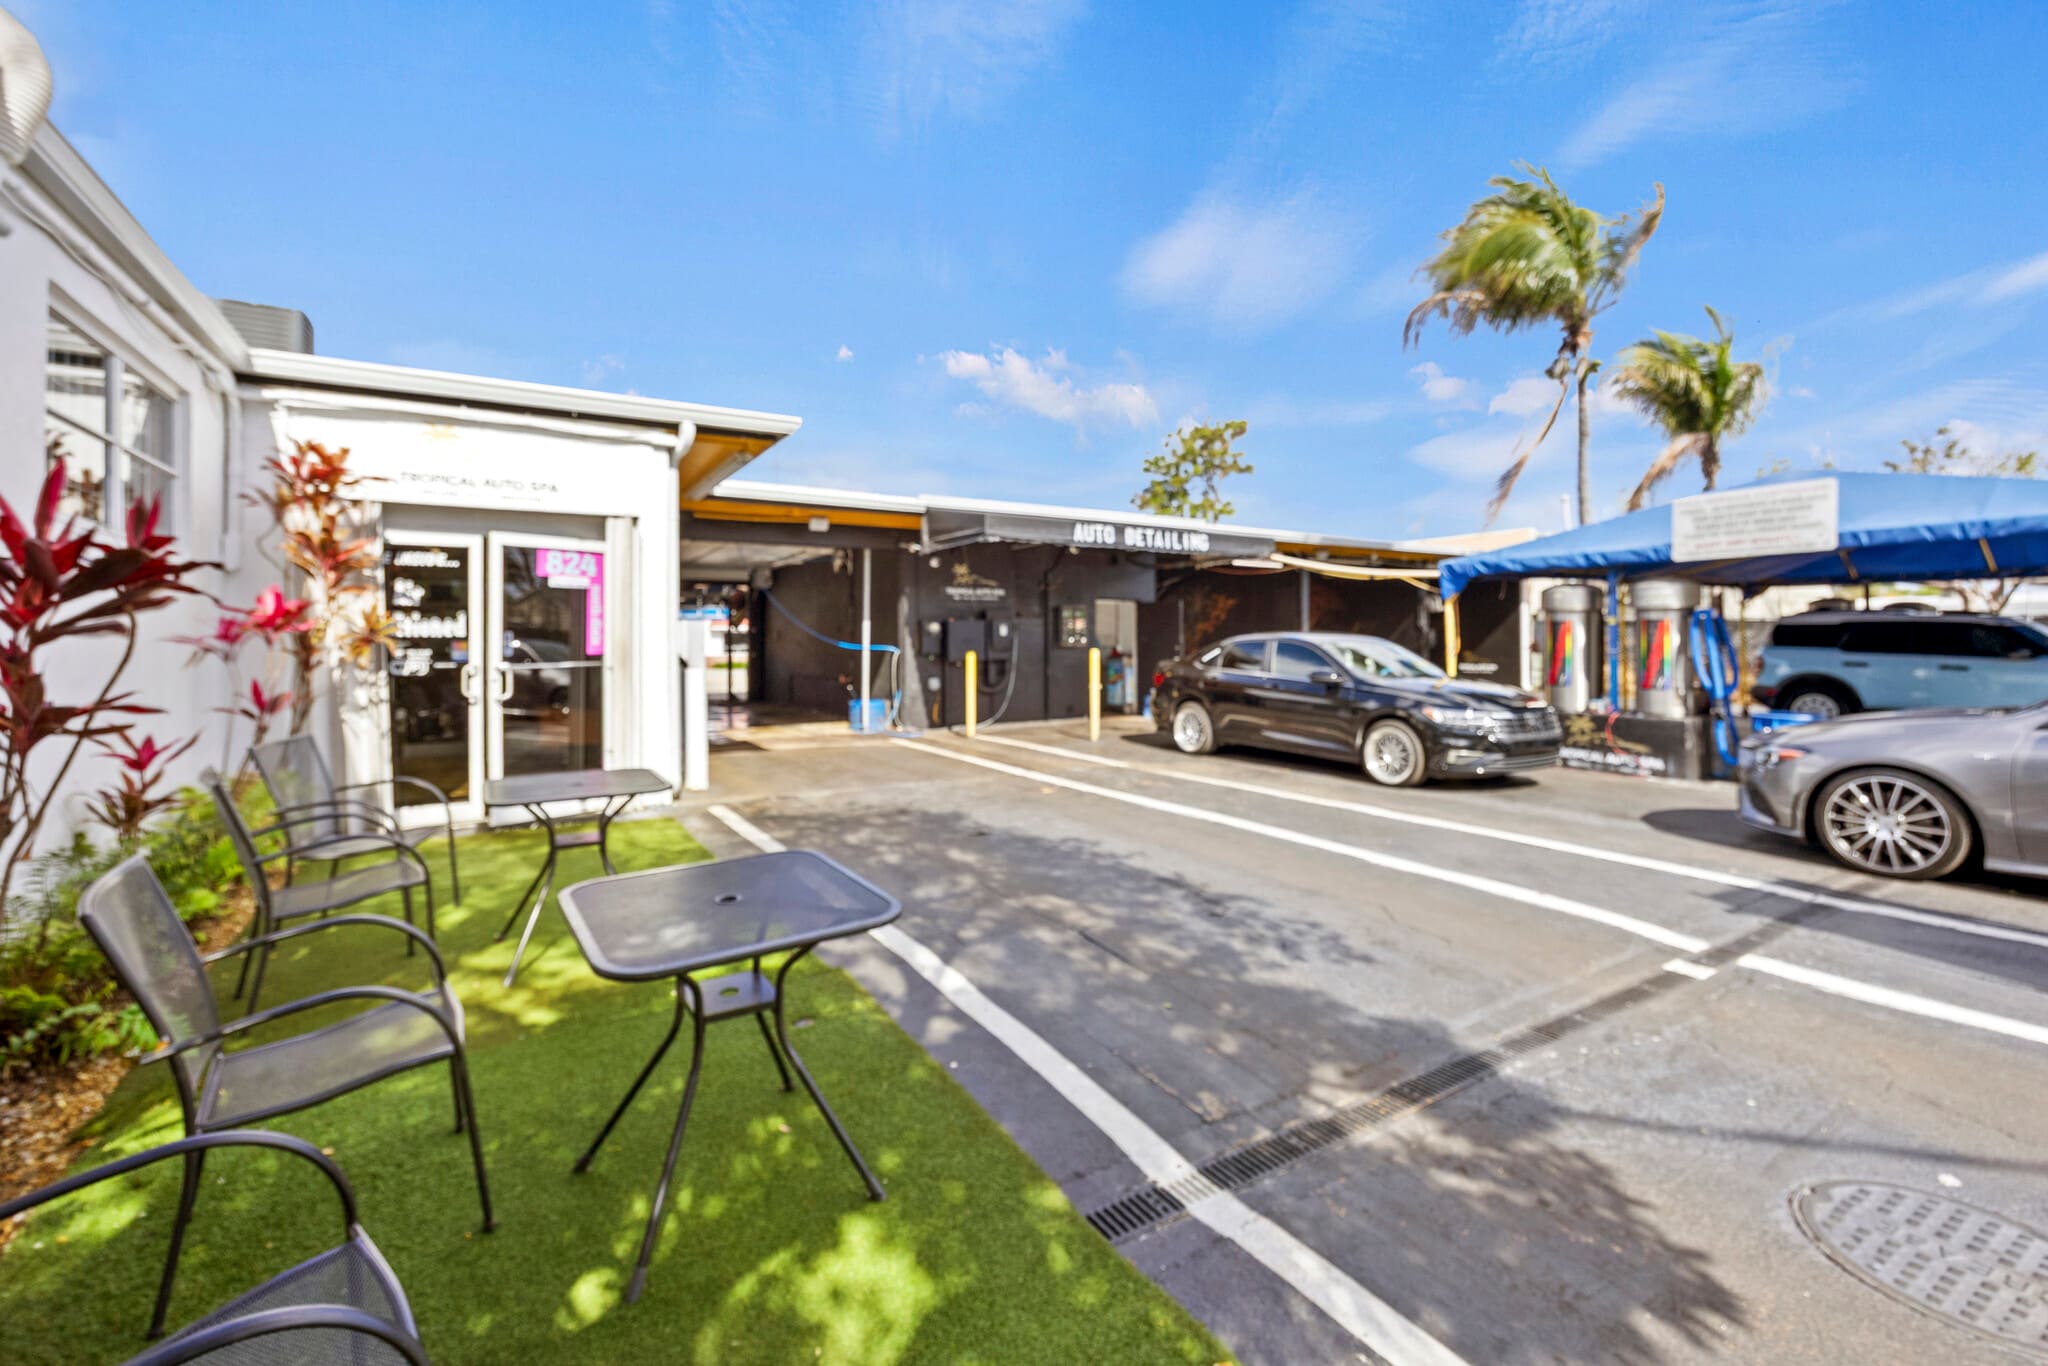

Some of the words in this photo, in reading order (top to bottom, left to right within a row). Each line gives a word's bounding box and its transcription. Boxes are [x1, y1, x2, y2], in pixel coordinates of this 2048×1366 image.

[1073, 521, 1116, 544] AUTO
[1124, 526, 1210, 552] DETAILING
[546, 550, 597, 577] 824
